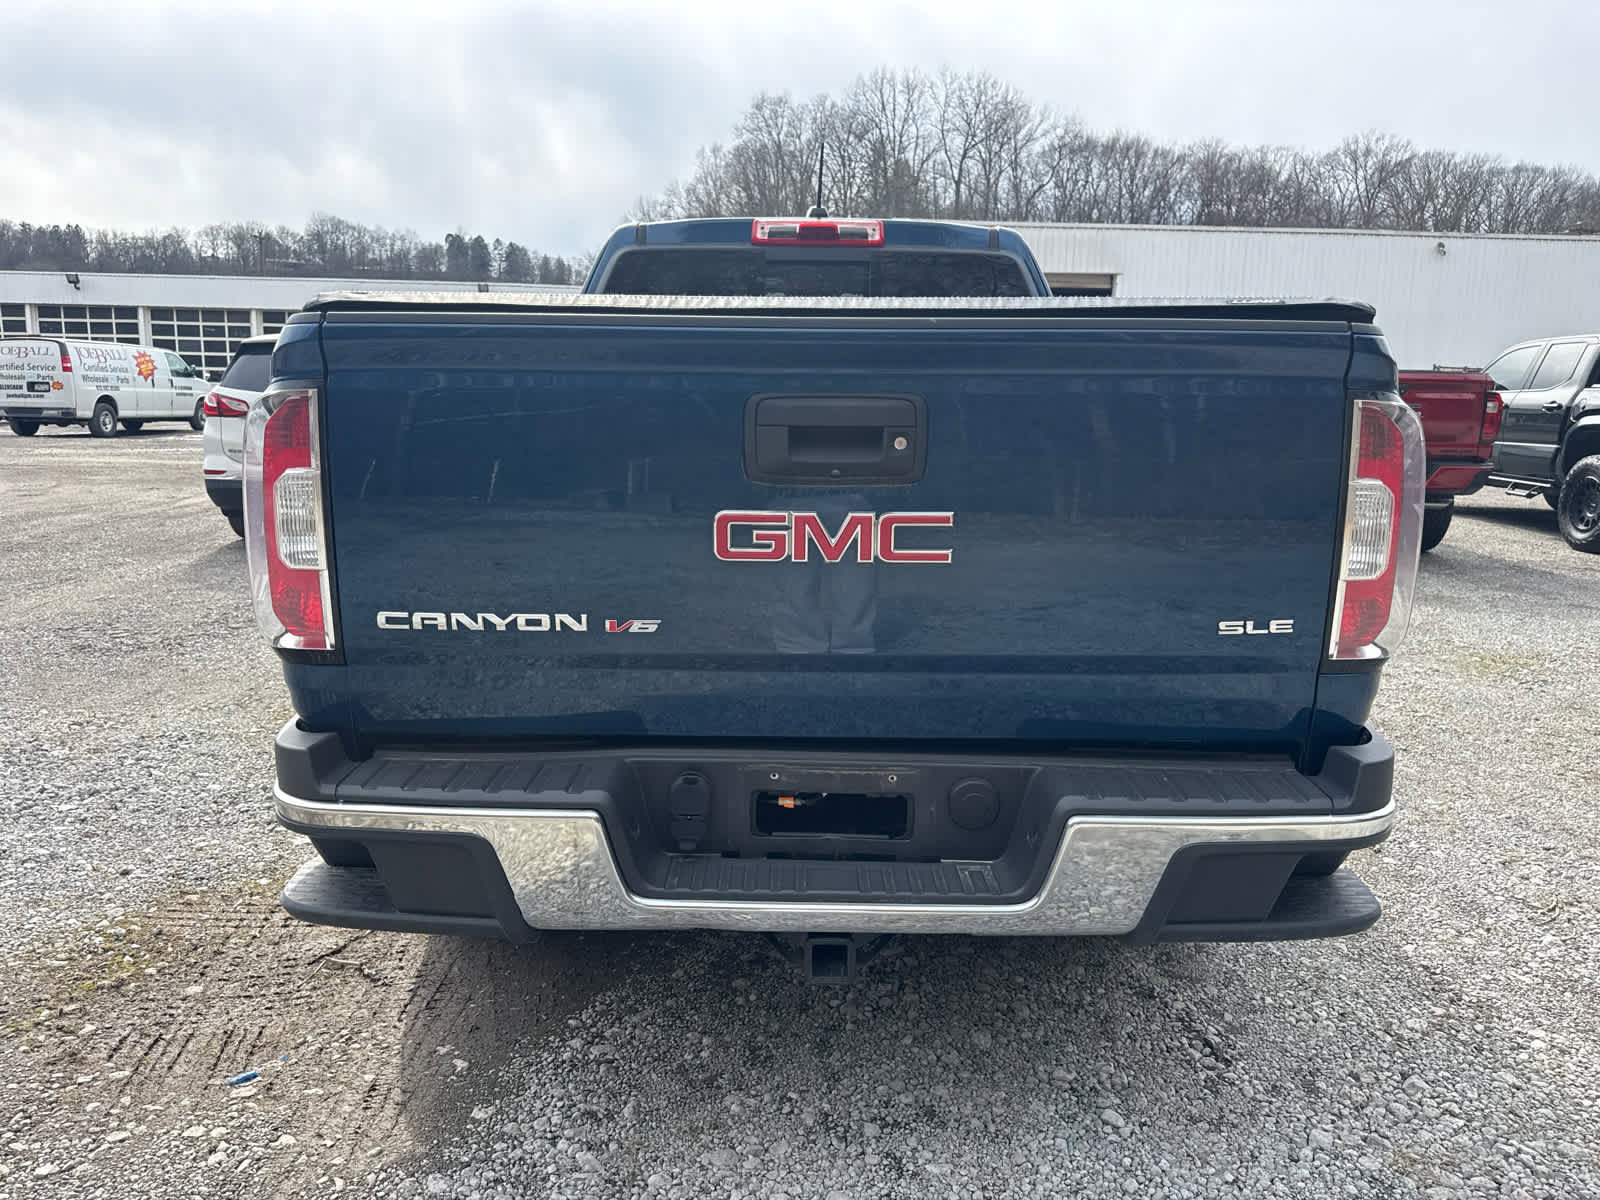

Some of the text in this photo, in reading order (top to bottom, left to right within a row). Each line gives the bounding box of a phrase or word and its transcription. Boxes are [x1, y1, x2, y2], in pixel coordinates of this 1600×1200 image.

[0, 362, 57, 372] ertified Service
[83, 362, 109, 373] Certified
[110, 363, 129, 374] Service
[37, 373, 54, 381] Parts
[713, 509, 955, 564] GMC
[376, 611, 662, 633] CANYON V6
[1218, 619, 1294, 635] SLE
